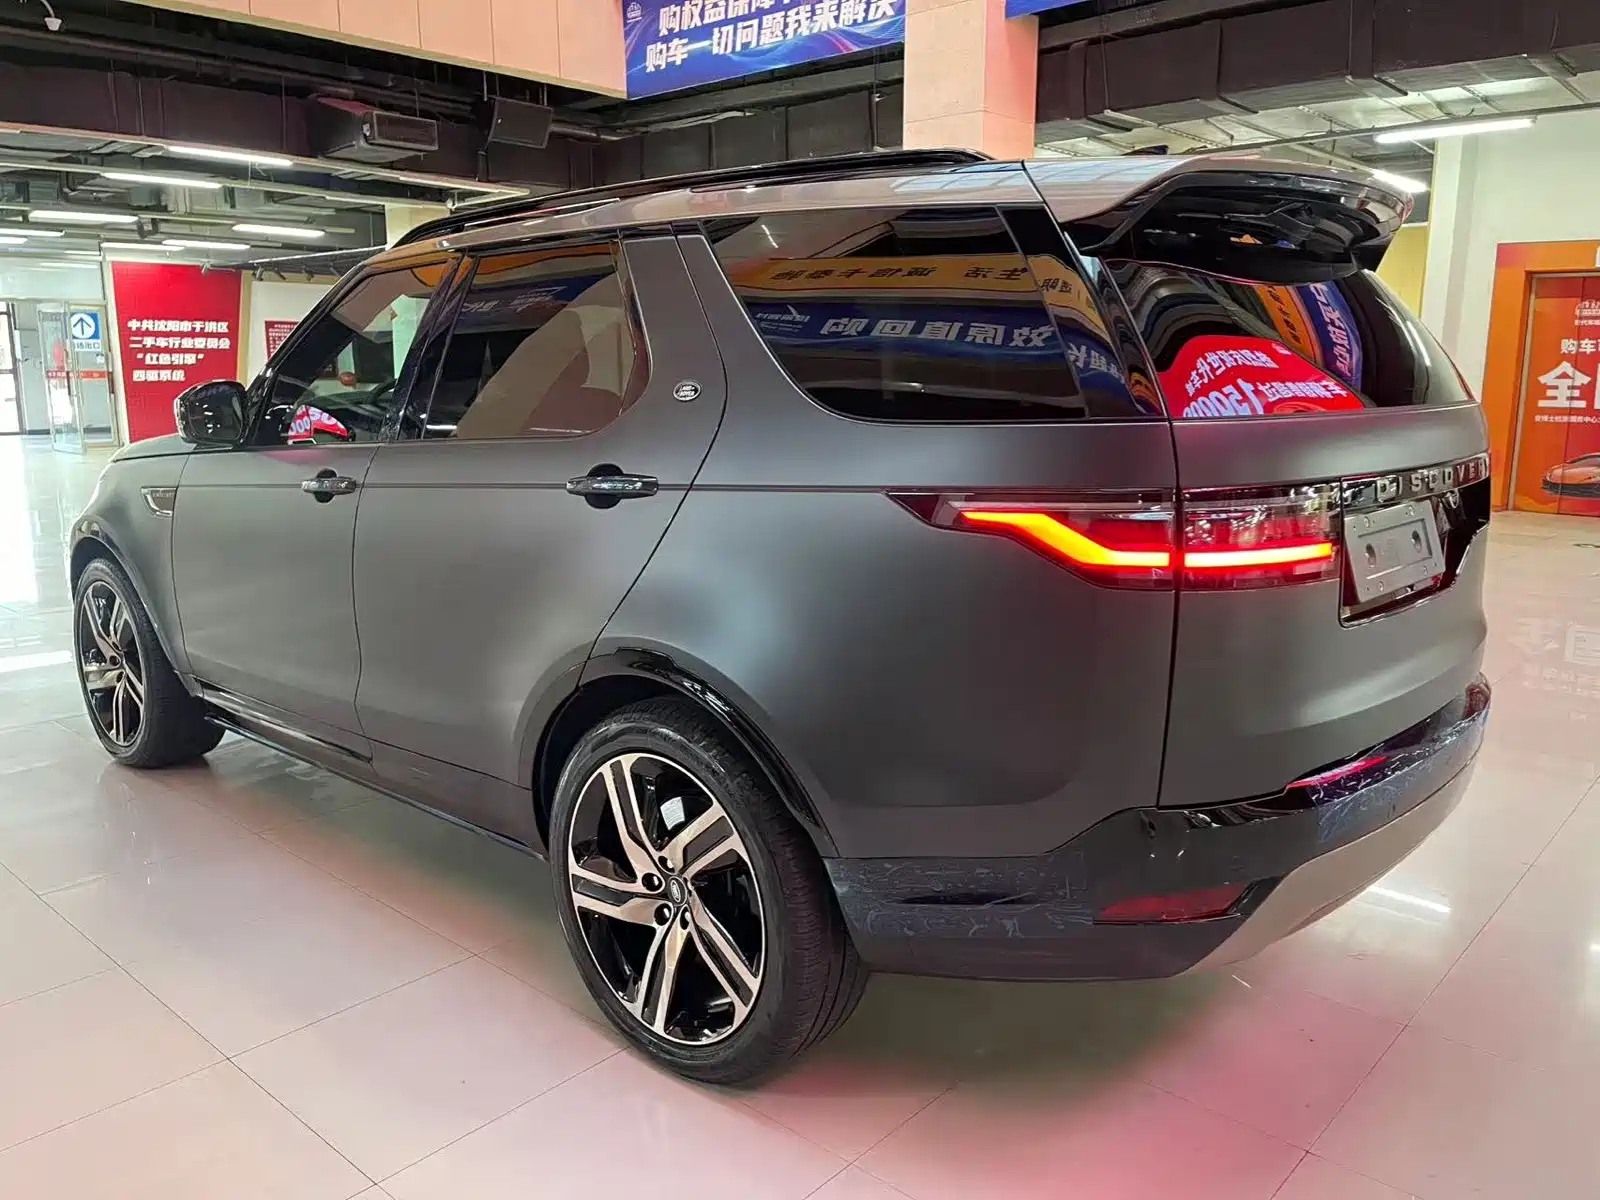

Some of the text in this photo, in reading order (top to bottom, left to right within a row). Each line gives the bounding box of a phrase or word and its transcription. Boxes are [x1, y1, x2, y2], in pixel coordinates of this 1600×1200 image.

[645, 0, 898, 73] 购车一切问题我来解决
[127, 318, 229, 333] 中共沈阳市于洪区
[1560, 338, 1600, 355] 购车
[1537, 360, 1600, 410] 全
